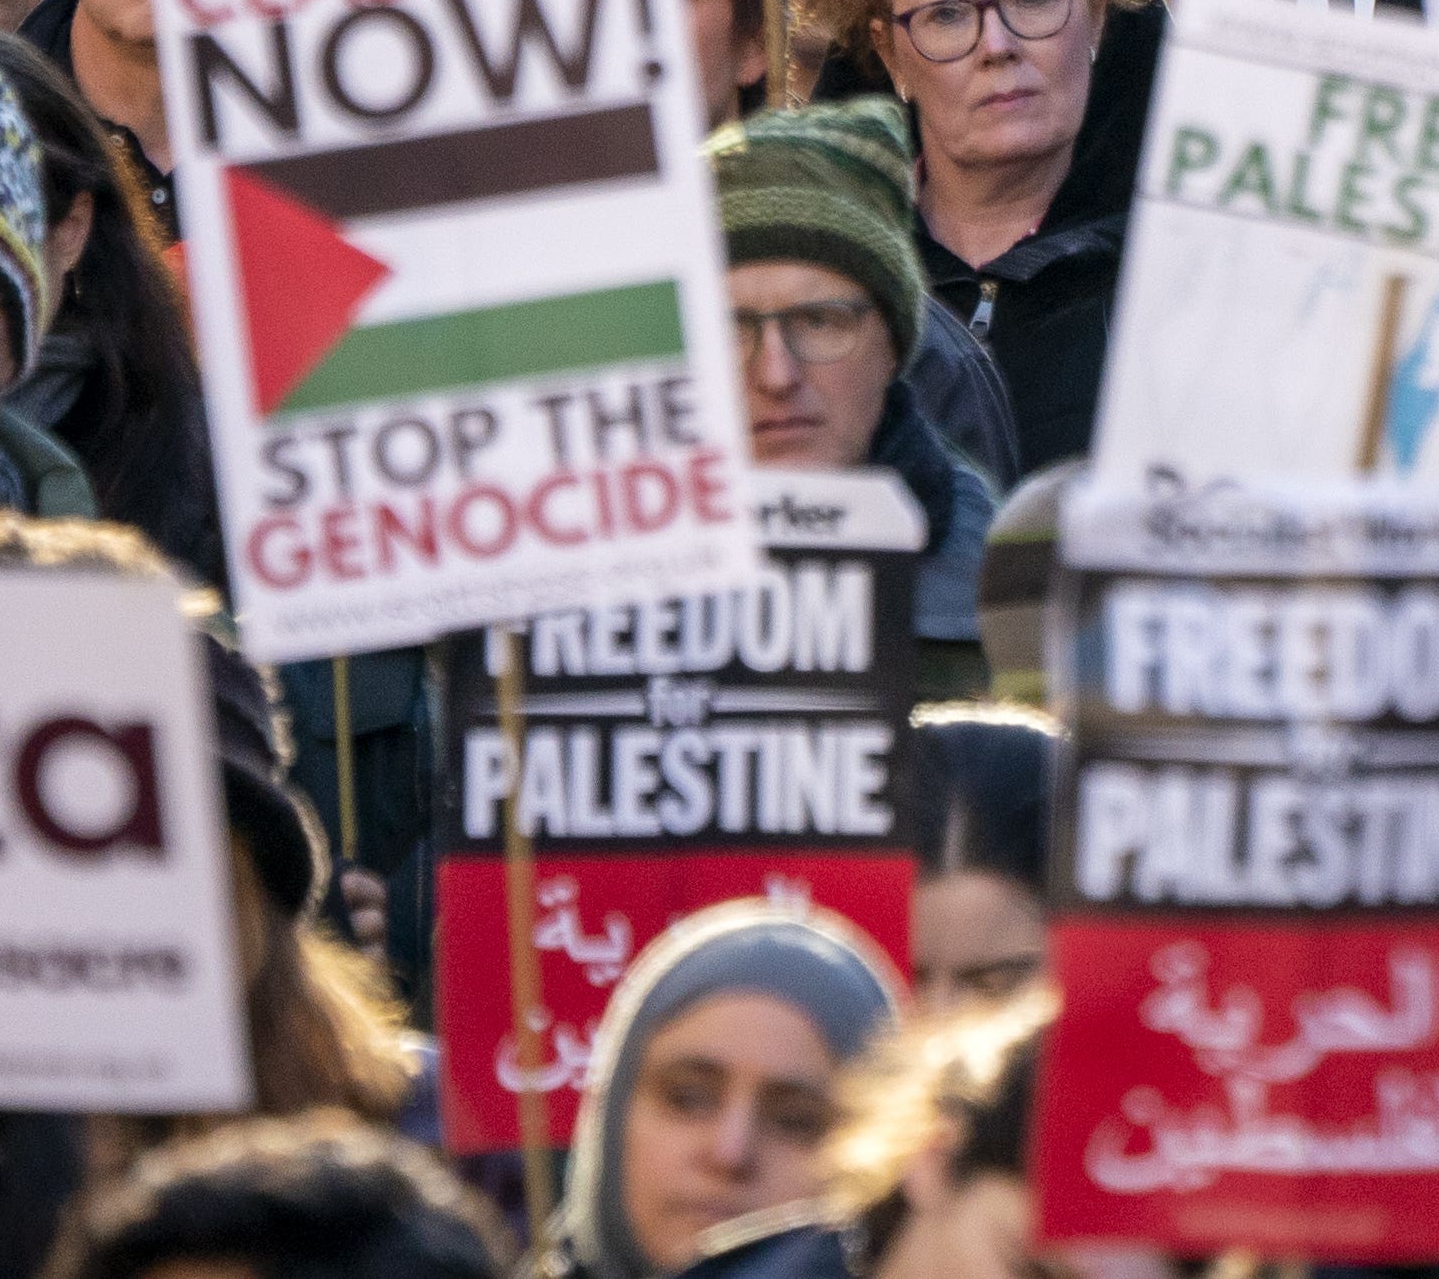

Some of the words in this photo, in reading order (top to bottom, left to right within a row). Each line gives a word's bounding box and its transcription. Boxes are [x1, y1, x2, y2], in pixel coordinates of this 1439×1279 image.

[259, 405, 500, 516] STOP
[538, 373, 701, 465] THE
[245, 447, 738, 593] GENOCIDE
[484, 561, 874, 679] FREEDOM
[464, 725, 893, 841] PALESTINE
